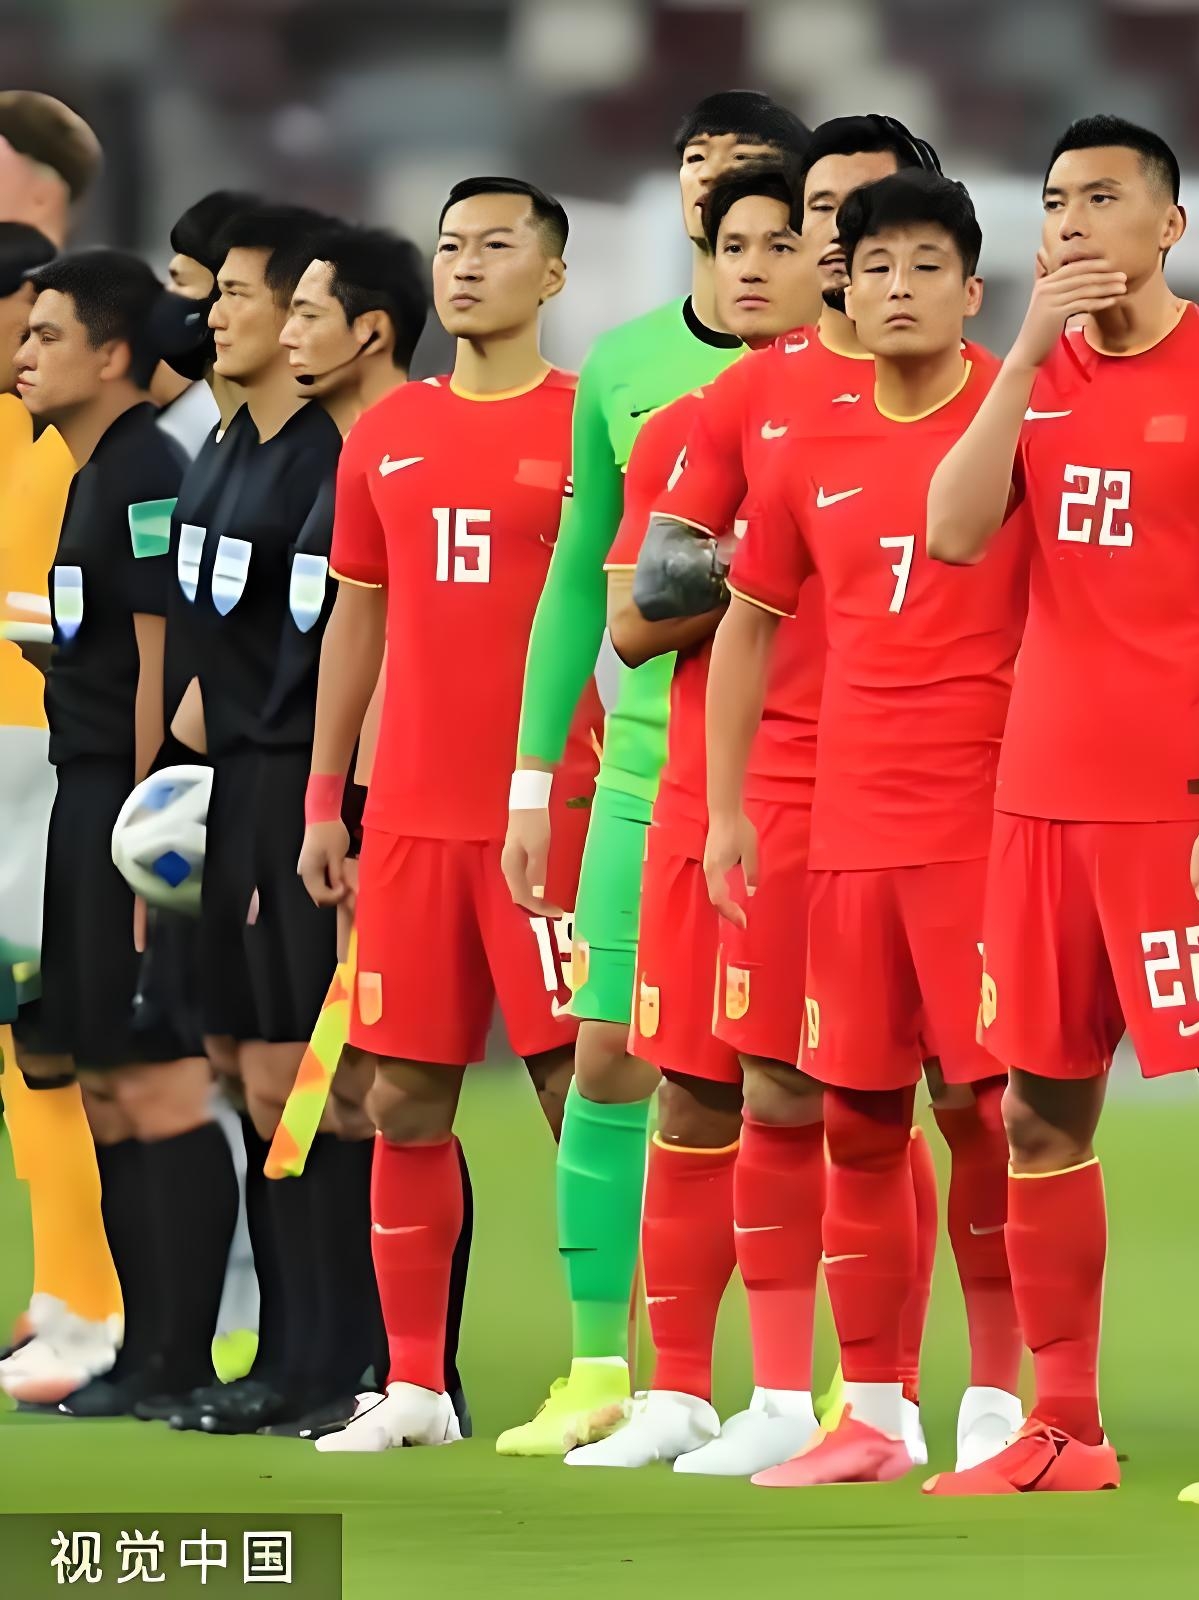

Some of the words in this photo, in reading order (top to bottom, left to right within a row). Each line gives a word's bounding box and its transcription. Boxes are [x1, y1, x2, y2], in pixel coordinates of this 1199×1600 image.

[432, 507, 491, 583] 15
[1058, 463, 1133, 547] 22
[879, 534, 915, 614] 7
